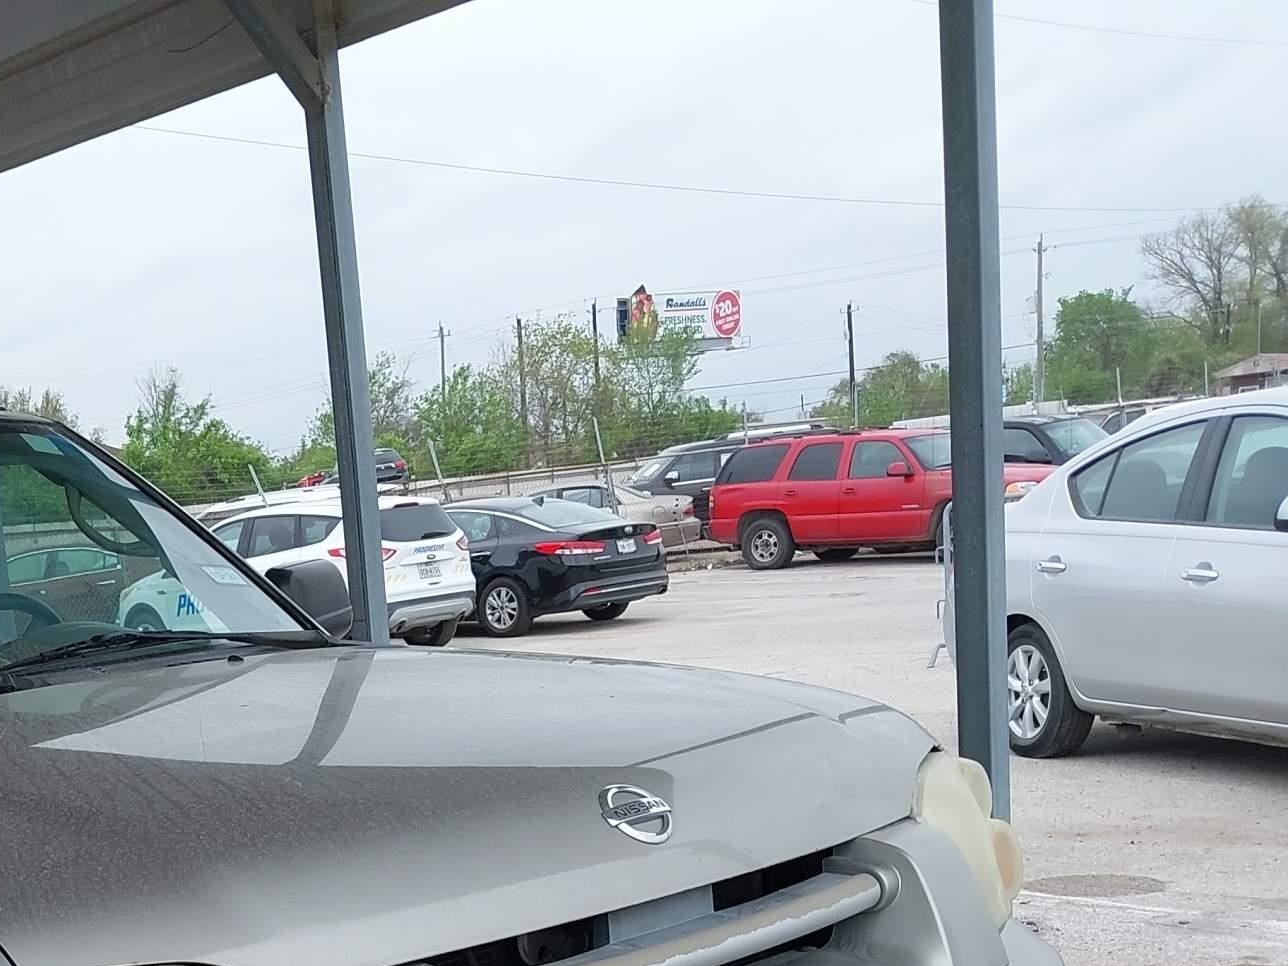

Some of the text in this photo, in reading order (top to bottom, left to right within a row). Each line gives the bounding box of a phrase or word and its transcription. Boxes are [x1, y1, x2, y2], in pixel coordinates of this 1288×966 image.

[666, 297, 706, 309] Randalls
[715, 300, 732, 317] $20
[614, 799, 666, 819] NISSAN
